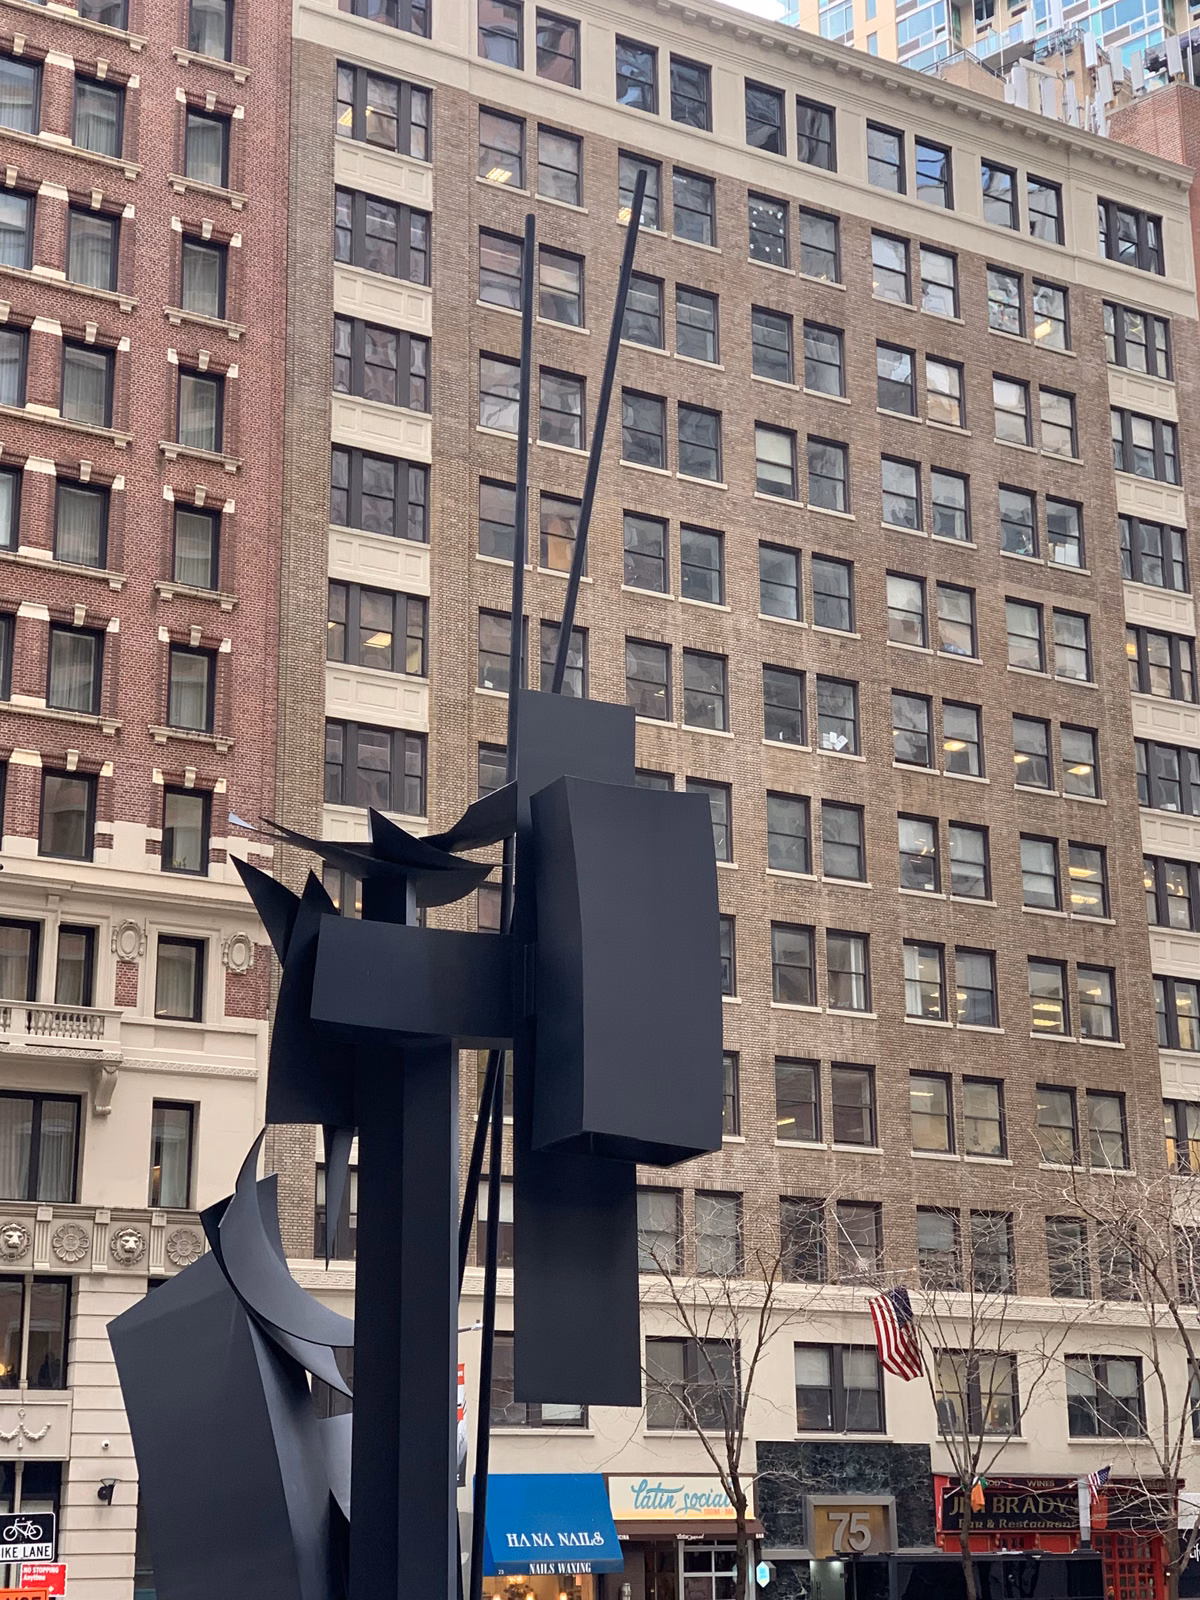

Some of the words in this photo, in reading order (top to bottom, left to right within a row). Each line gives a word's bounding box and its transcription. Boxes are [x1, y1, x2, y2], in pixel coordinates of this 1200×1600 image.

[949, 1496, 986, 1516] JI
[987, 1519, 995, 1529] &
[828, 1512, 872, 1551] 75
[557, 1531, 605, 1546] NAILS
[1, 1547, 19, 1559] IKE
[23, 1545, 51, 1558] LANE
[23, 1566, 32, 1574] NO
[32, 1566, 60, 1574] STOPPING
[529, 1563, 555, 1575] NAILS
[557, 1562, 592, 1574] WAXING
[23, 1574, 47, 1582] Anytime
